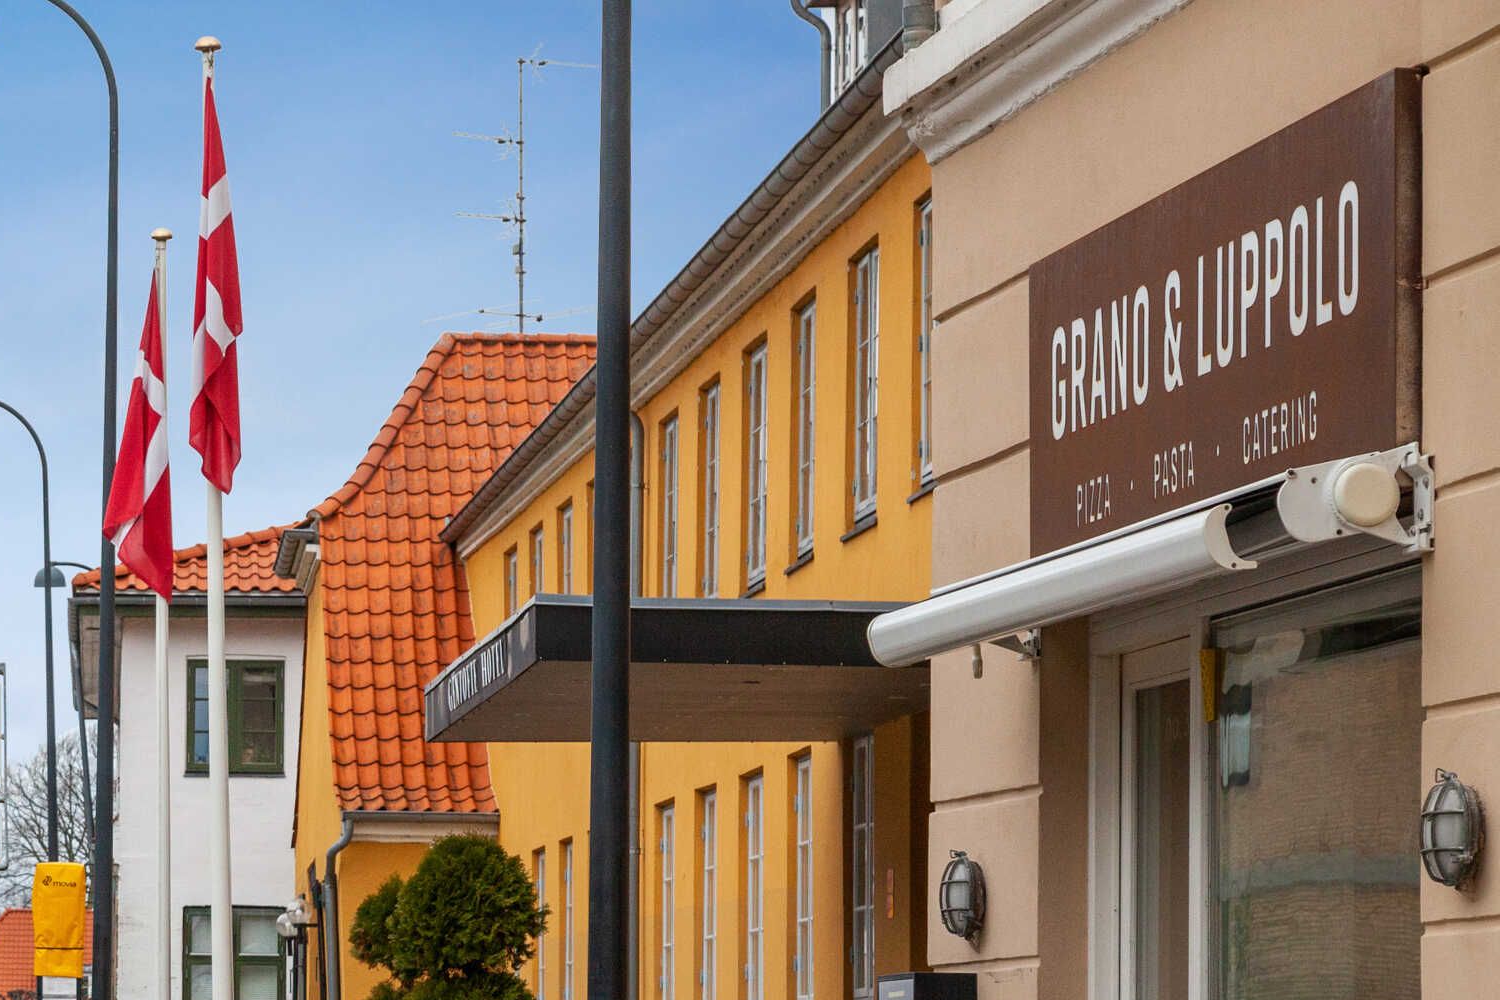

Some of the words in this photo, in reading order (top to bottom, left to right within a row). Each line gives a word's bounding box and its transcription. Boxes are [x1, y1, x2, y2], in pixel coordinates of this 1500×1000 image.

[1052, 285, 1150, 441] GRANO
[1164, 270, 1184, 393] &
[1197, 180, 1359, 377] LUPPOLO
[1076, 474, 1111, 527] PIZZA
[1154, 441, 1195, 499] PASTA
[1243, 391, 1317, 465] CATERING
[480, 639, 505, 689] HOTEL
